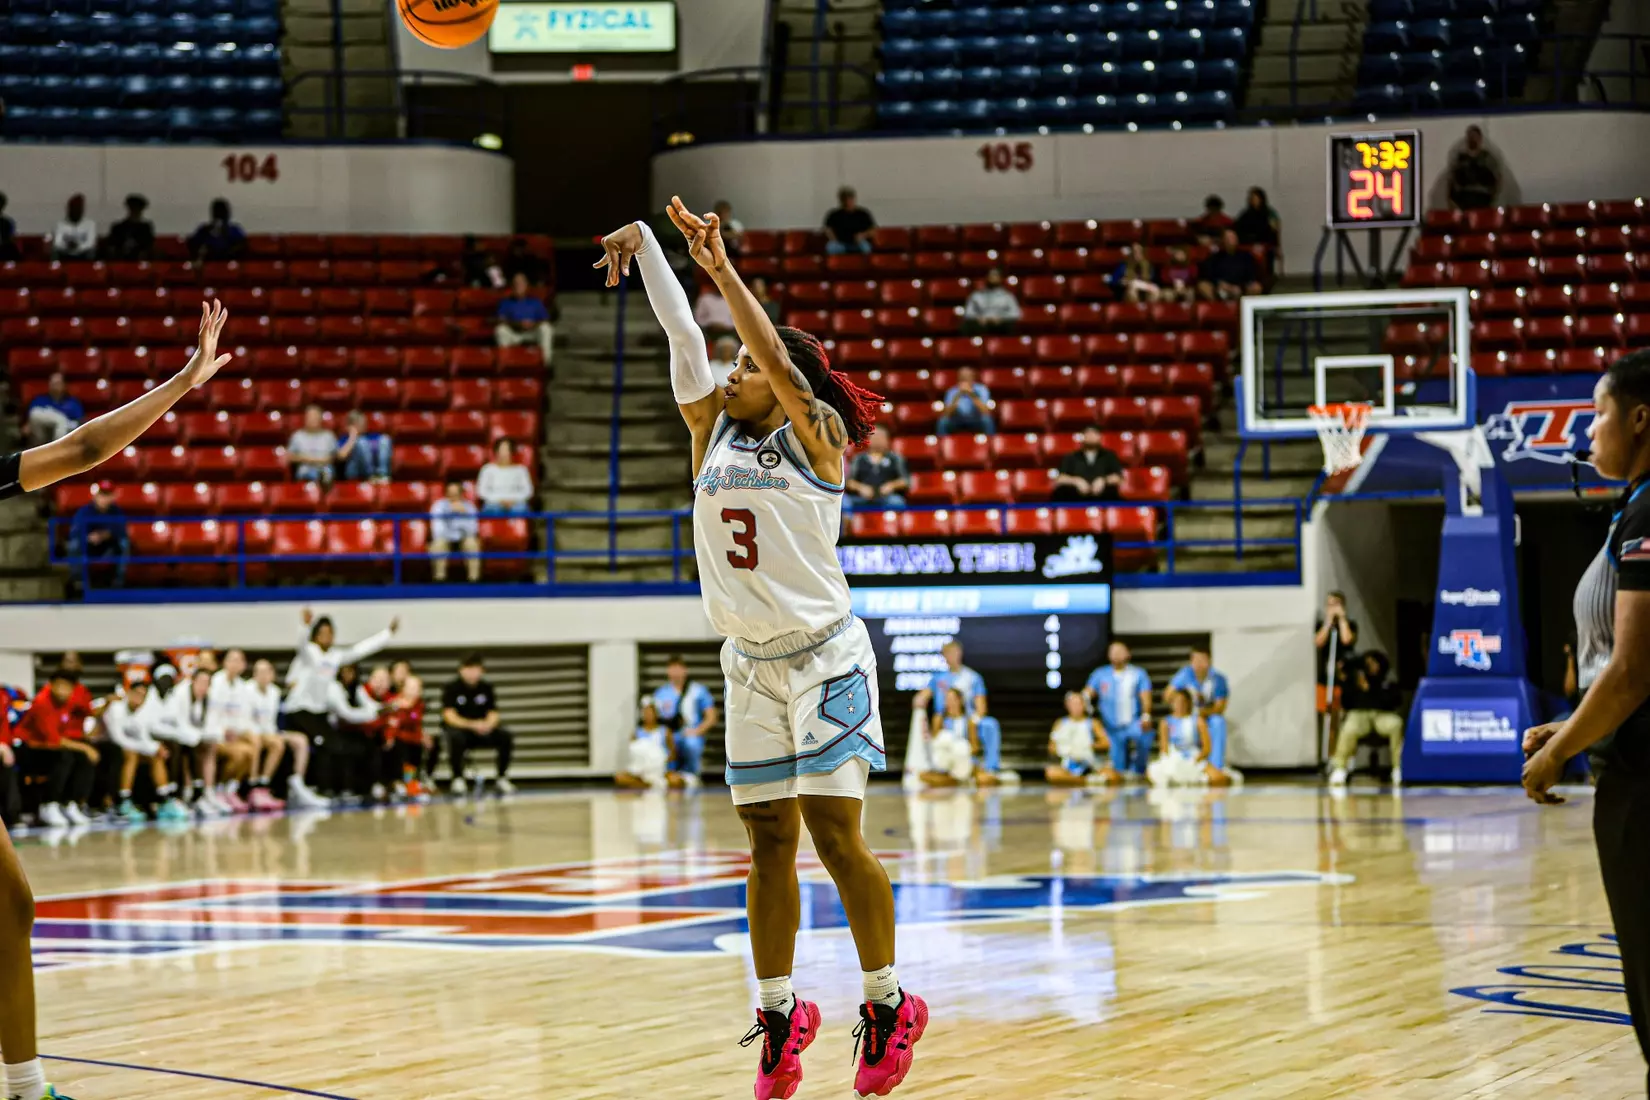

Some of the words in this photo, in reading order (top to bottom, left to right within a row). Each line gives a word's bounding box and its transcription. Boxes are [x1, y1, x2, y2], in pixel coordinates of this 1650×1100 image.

[547, 8, 653, 30] FYZICAL
[220, 152, 280, 184] 104
[977, 142, 1034, 173] 105
[1355, 140, 1410, 169] 7:32
[1347, 169, 1403, 218] 24
[721, 465, 790, 491] Techsters
[720, 507, 759, 571] 3
[801, 738, 819, 746] adidas
